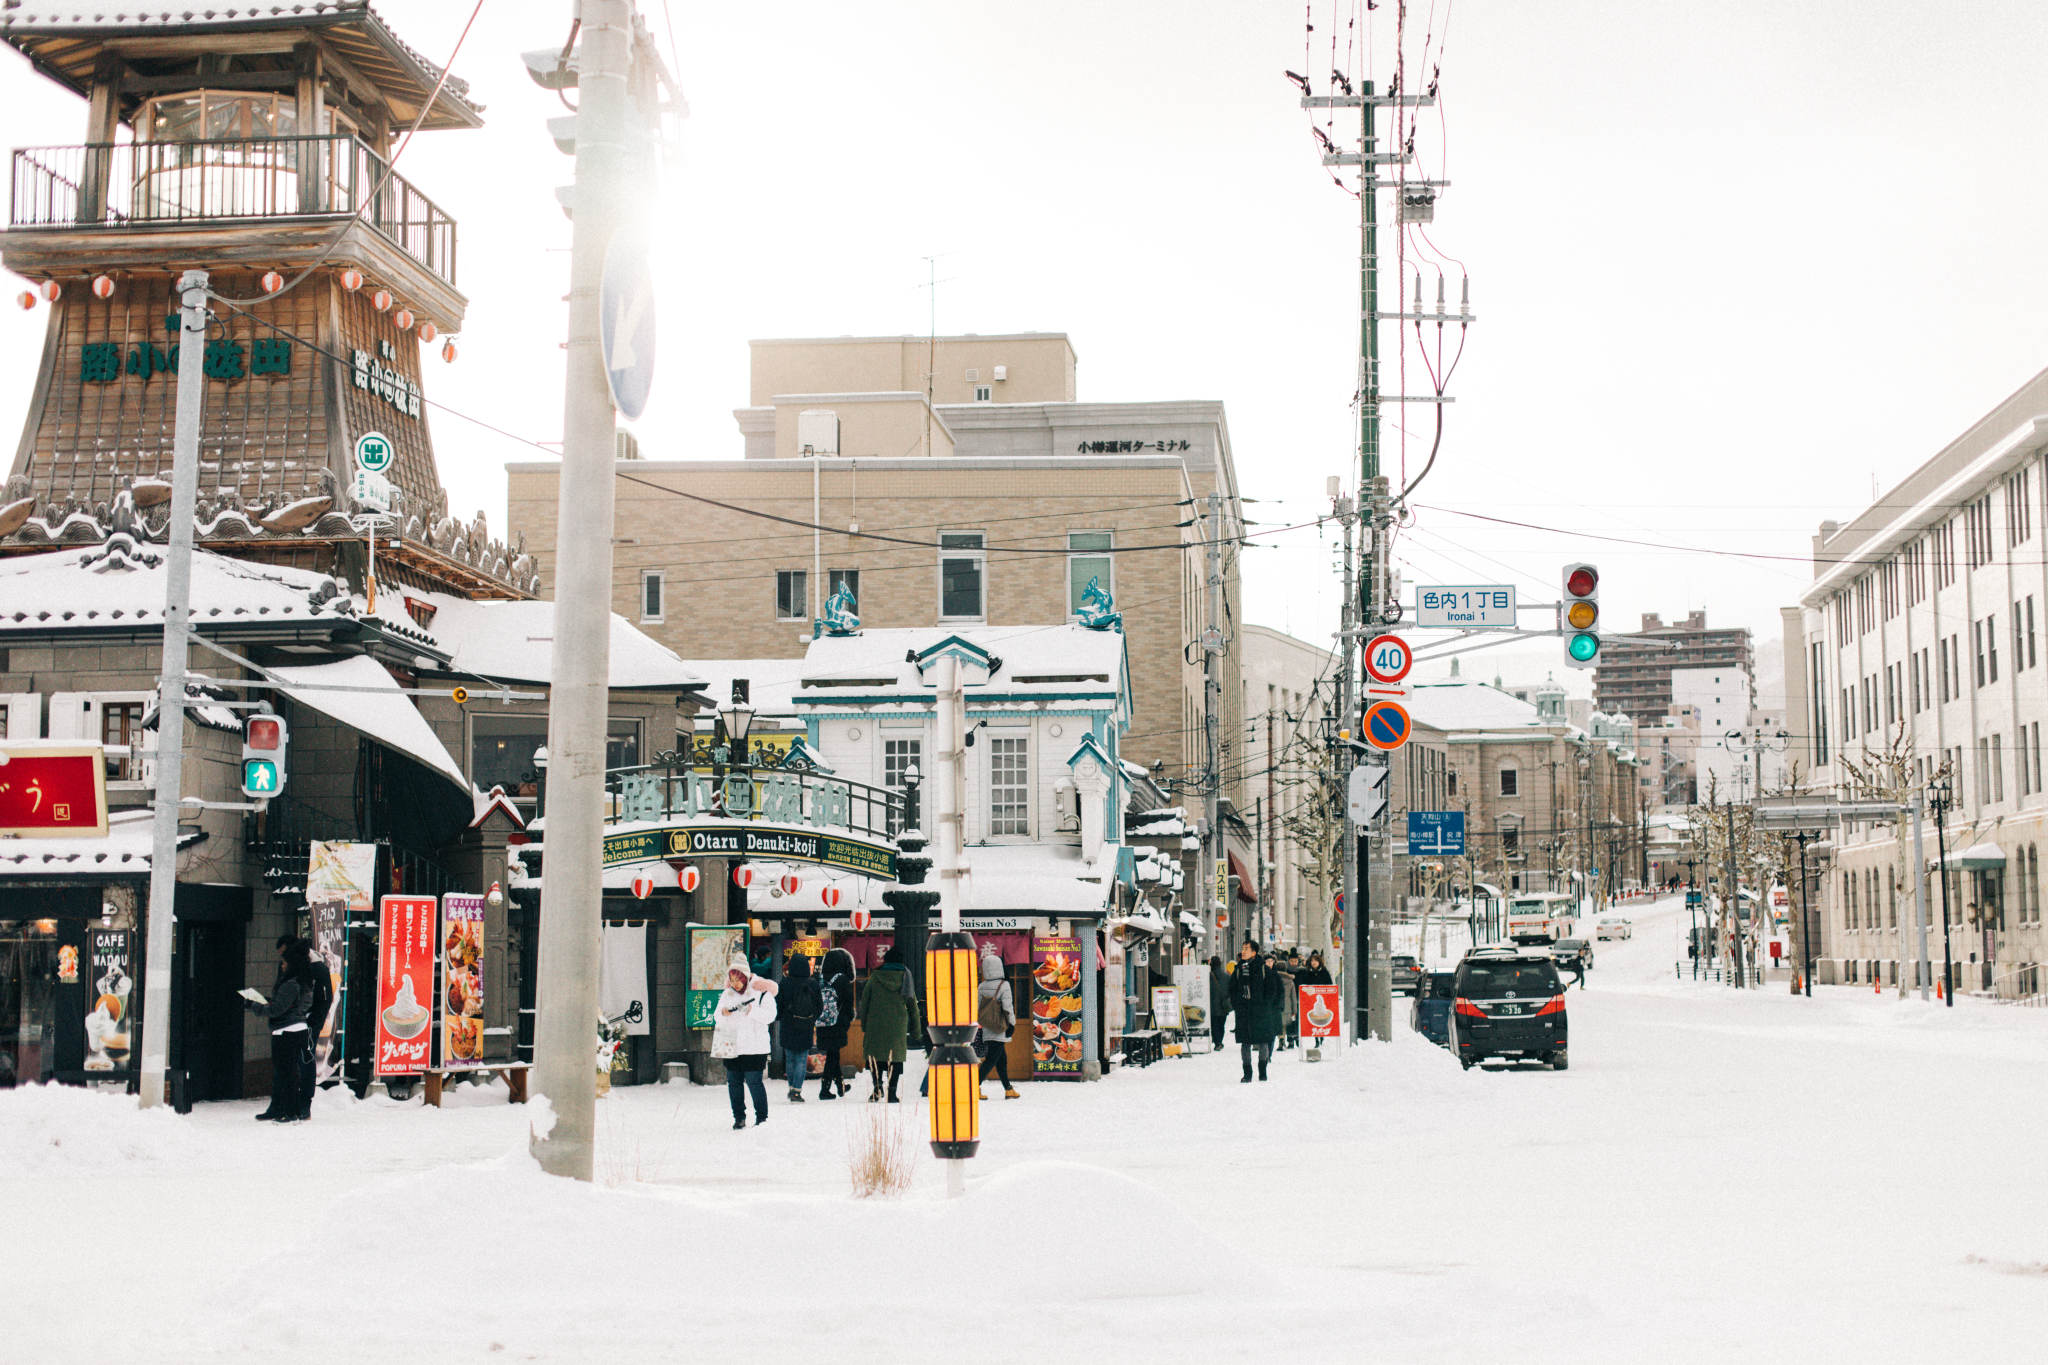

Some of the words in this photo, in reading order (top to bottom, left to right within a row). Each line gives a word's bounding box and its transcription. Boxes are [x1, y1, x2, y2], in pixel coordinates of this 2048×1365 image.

[1077, 439, 1191, 454] 小樽運河ターミナル
[1423, 592, 1509, 610] 色内1丁目
[1447, 611, 1475, 622] Ironai
[1480, 611, 1486, 621] 1
[1376, 648, 1402, 670] 40
[693, 833, 739, 850] Otaru
[747, 834, 817, 857] Denuki-koji
[959, 919, 994, 928] Suisan
[996, 919, 1017, 928] No3
[96, 934, 125, 948] CAFE
[93, 954, 128, 967] WADOU
[381, 1063, 407, 1072] POPURA
[408, 1063, 427, 1071] FARM
